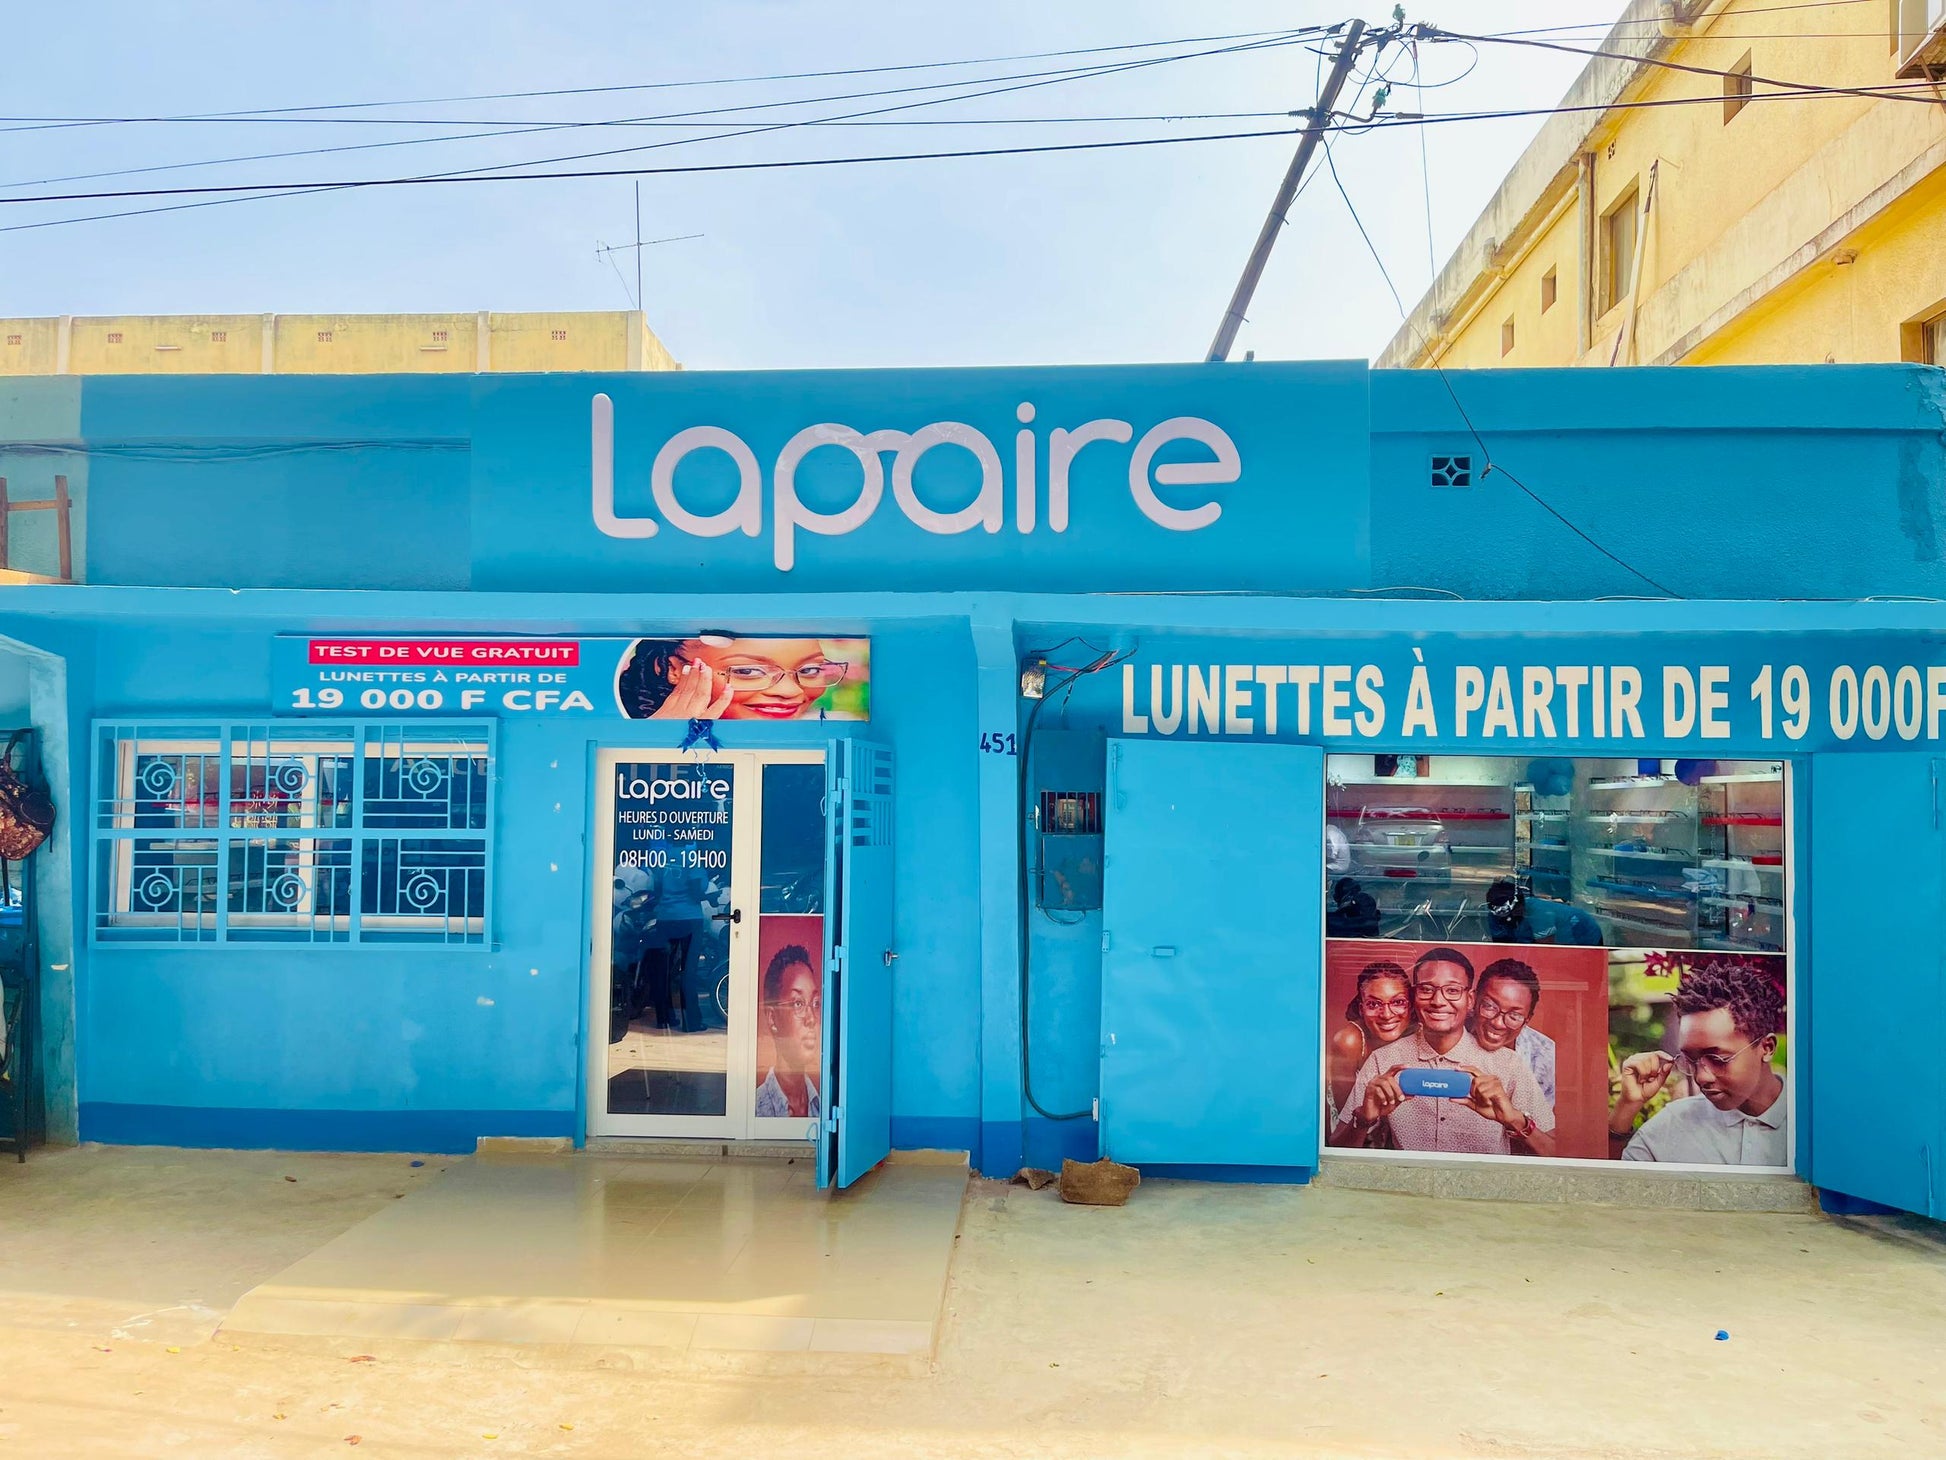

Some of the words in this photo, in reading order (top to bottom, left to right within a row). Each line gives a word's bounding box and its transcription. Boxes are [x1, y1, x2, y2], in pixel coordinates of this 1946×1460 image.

[591, 392, 1242, 572] Lapaire
[314, 645, 372, 658] TEST
[379, 646, 410, 658] DE
[417, 646, 464, 659] VUE
[471, 647, 574, 660] GRATUIT
[319, 671, 426, 683] LUNETTES
[433, 669, 449, 683] À
[455, 673, 531, 684] PARTIR
[538, 673, 567, 684] DE
[292, 687, 344, 709] 19
[360, 689, 443, 710] 000
[461, 690, 486, 710] F
[502, 690, 594, 711] CFA
[1122, 663, 1386, 738] LUNETTES
[1402, 647, 1438, 737] À
[1455, 665, 1645, 738] PARTIR
[1663, 665, 1731, 739] DE
[1751, 664, 1811, 740] 19
[980, 732, 1017, 755] 451
[619, 773, 730, 805] Lapaire
[619, 811, 657, 824] HEURES
[660, 811, 668, 824] D
[669, 811, 729, 824] OUVERTURE
[633, 829, 665, 841] LUNDI
[673, 829, 714, 841] SAMEDI
[619, 850, 667, 868] 08H00
[680, 850, 727, 868] 19H00
